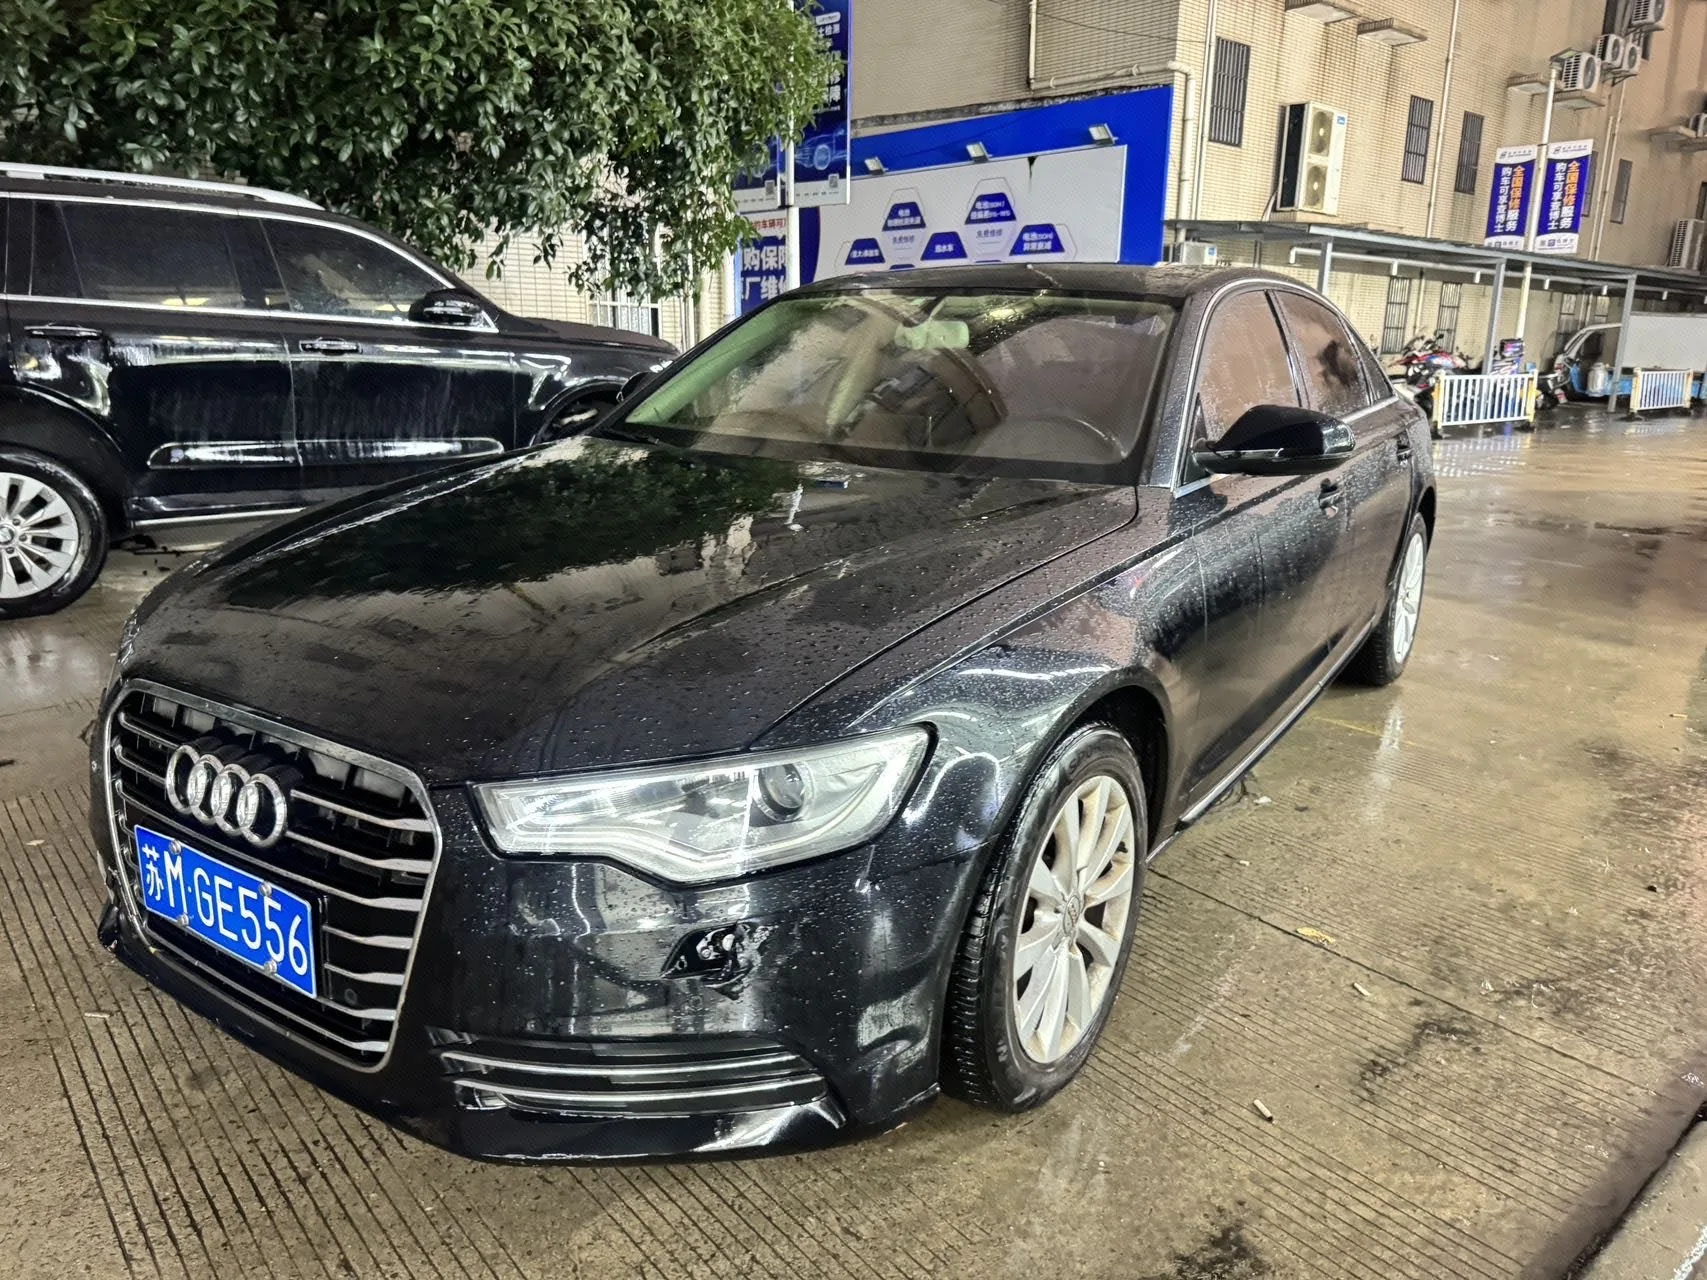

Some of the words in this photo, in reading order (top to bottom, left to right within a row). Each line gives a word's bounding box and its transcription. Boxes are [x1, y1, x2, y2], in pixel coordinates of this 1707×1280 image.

[741, 245, 787, 271] 购保
[741, 275, 787, 300] 厂维
[142, 843, 307, 975] 苏M·GE556
